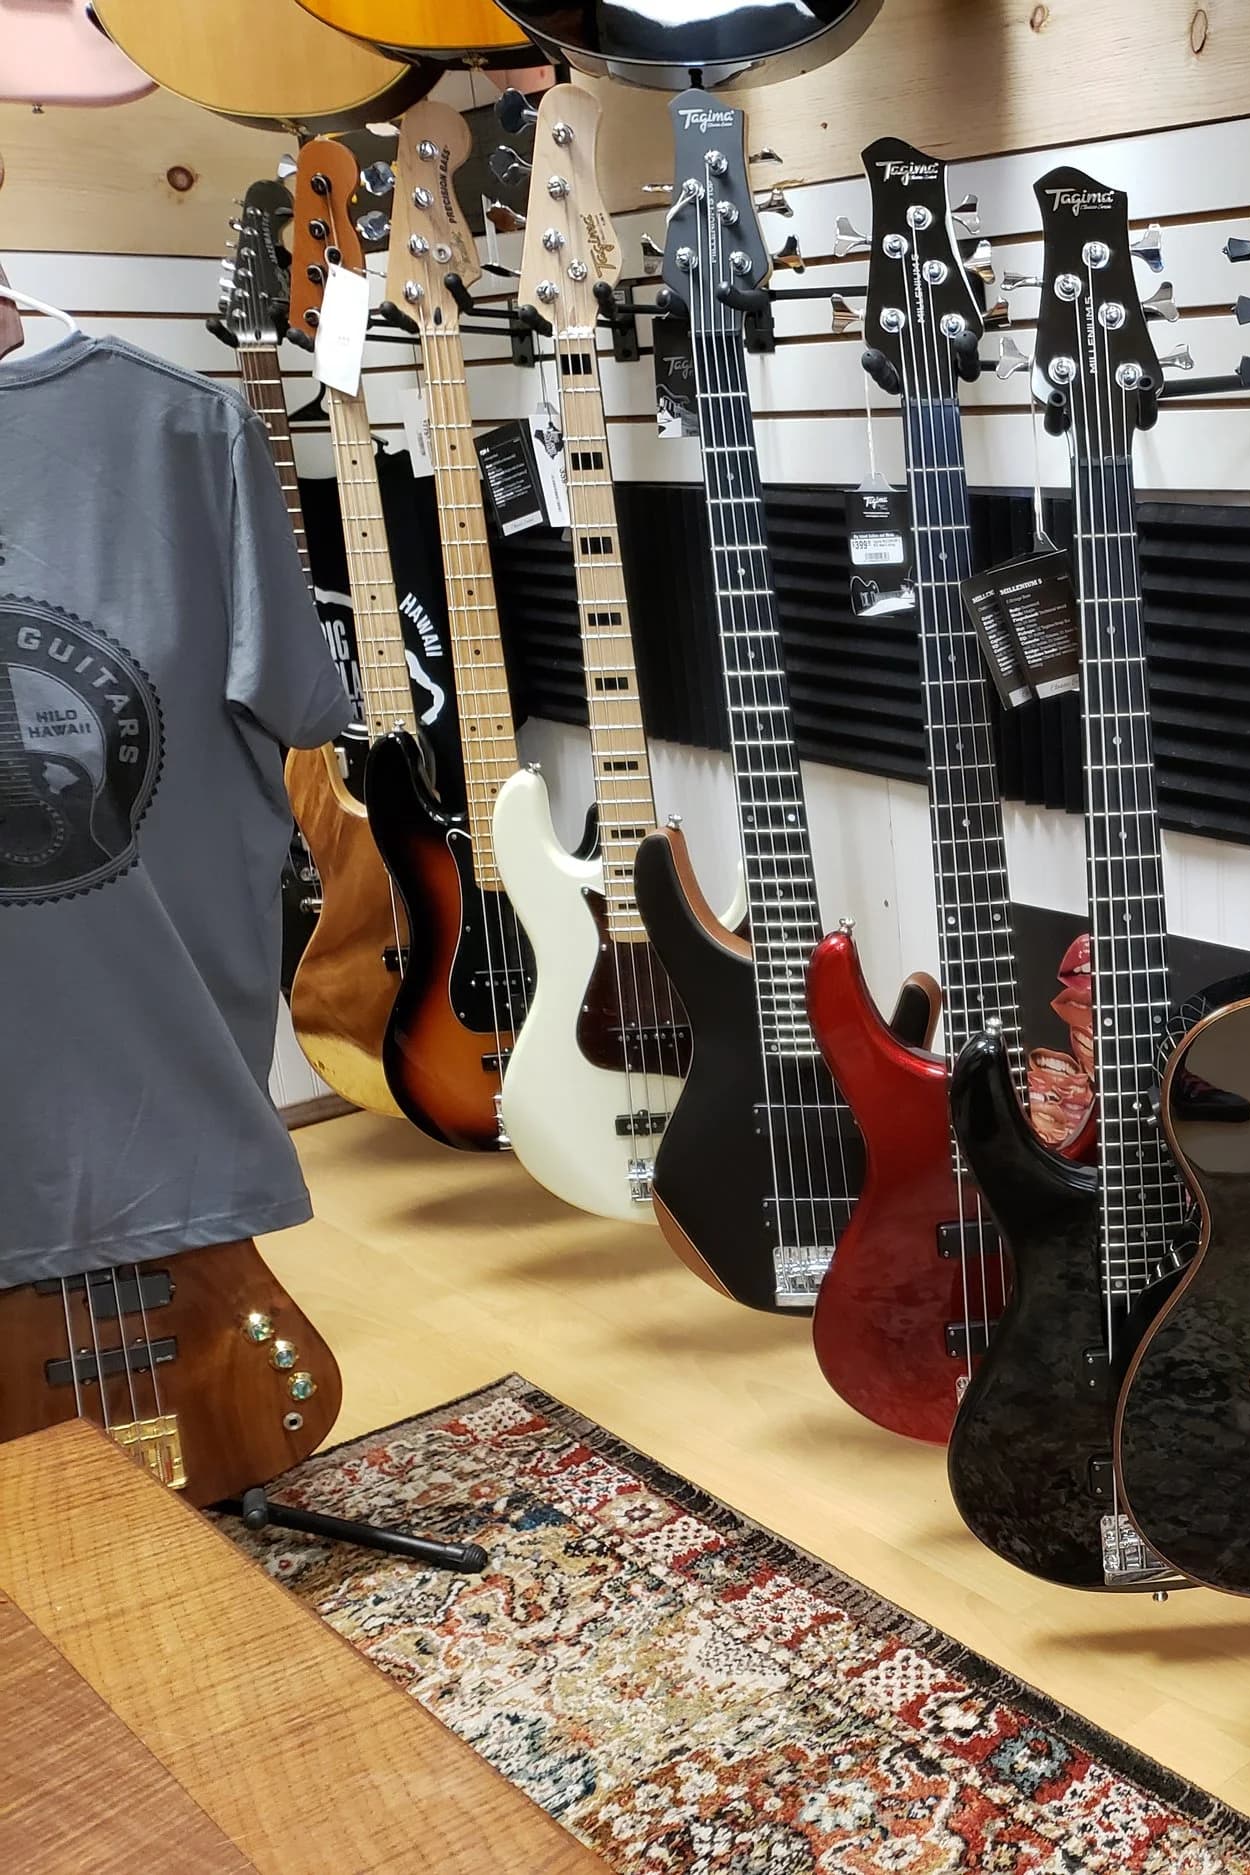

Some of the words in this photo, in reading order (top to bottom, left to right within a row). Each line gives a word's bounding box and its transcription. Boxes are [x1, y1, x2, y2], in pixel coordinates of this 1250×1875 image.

[678, 109, 734, 133] Tagima
[439, 148, 451, 173] BASS
[875, 161, 939, 186] Tagima
[439, 174, 457, 224] PRECISION
[1045, 188, 1115, 217] Tagima
[1084, 306, 1097, 374] MILLENIUM
[399, 592, 443, 657] HAWAII
[17, 626, 139, 763] GUITARS
[36, 710, 77, 723] HILO
[28, 723, 92, 738] HAWAII
